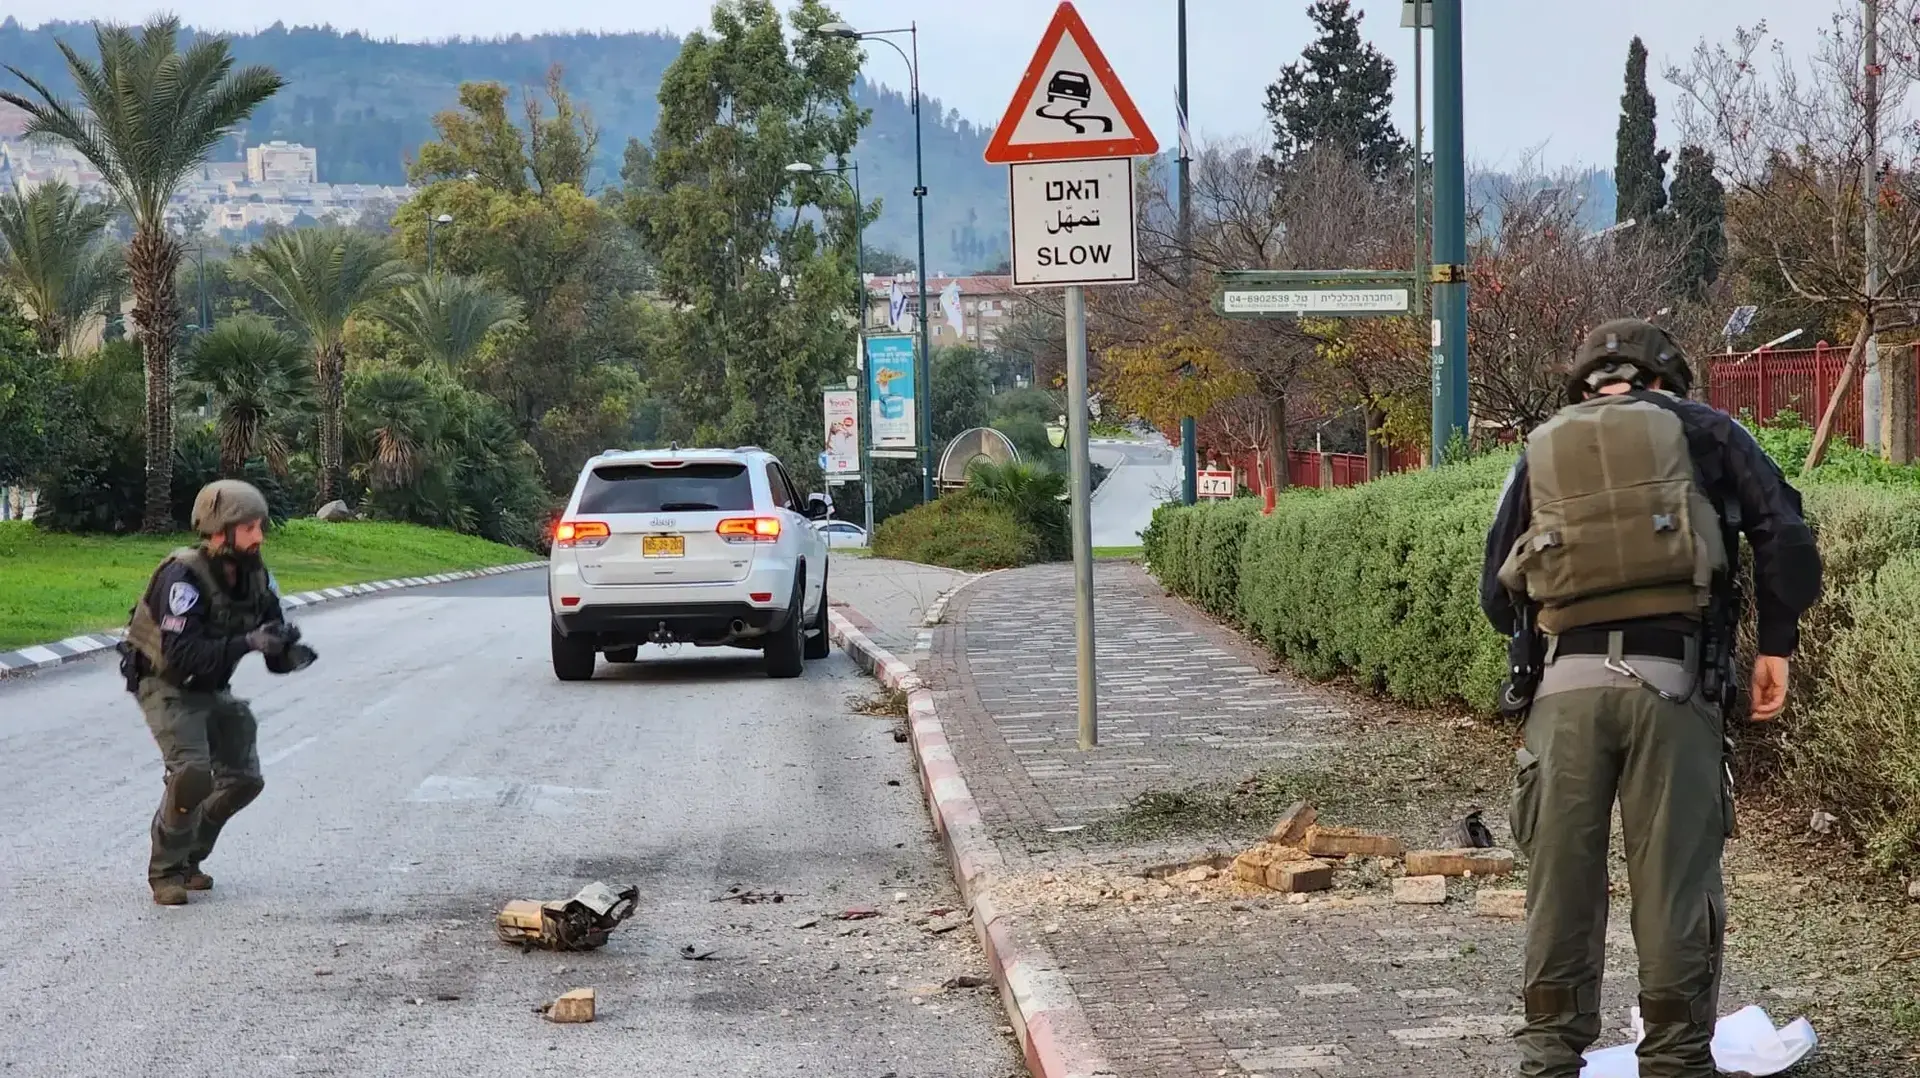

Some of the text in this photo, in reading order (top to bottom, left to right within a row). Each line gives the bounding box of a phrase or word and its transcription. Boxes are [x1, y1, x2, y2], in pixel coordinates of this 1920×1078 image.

[1046, 179, 1099, 201] האט
[1037, 244, 1112, 266] SLOW
[1321, 293, 1360, 303] הכלכלית
[1362, 293, 1393, 303] החברה
[1203, 480, 1227, 492] 471
[650, 516, 677, 528] Jeep
